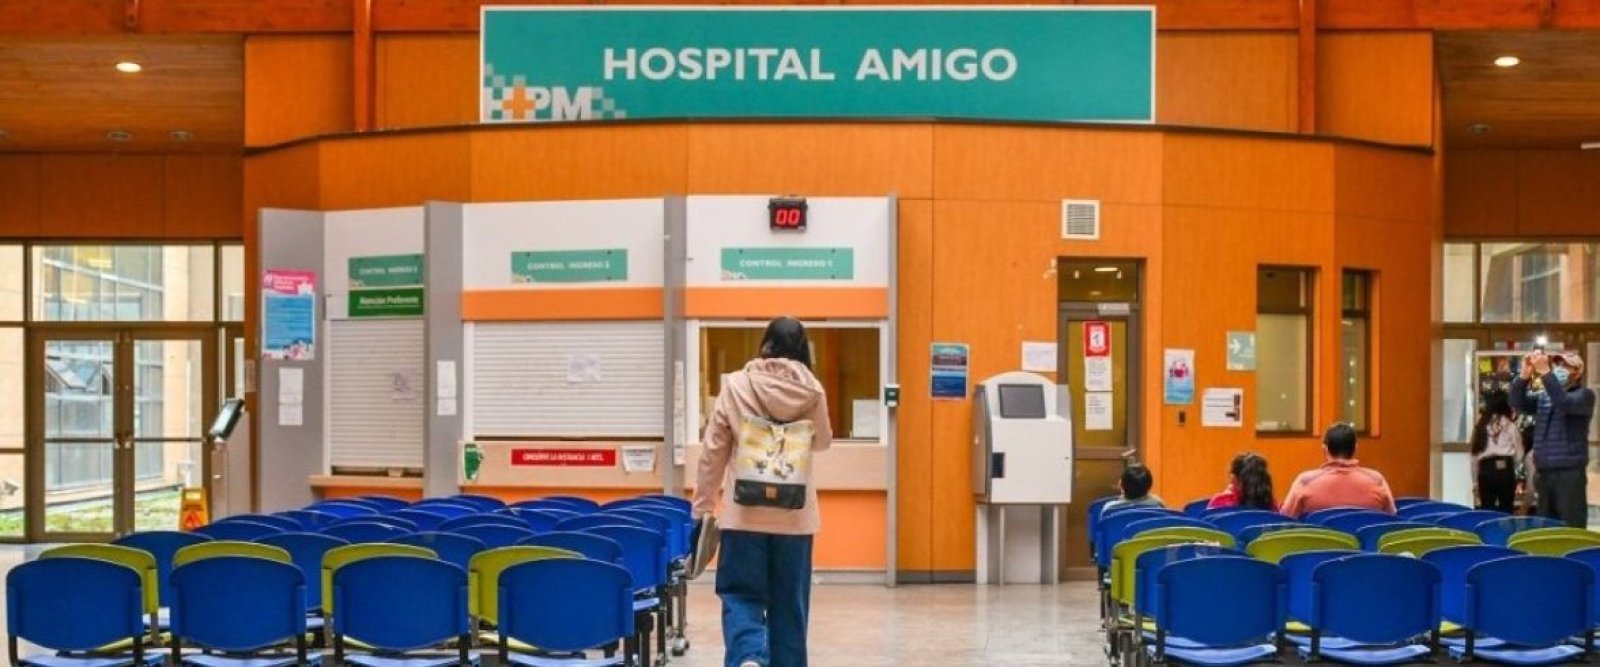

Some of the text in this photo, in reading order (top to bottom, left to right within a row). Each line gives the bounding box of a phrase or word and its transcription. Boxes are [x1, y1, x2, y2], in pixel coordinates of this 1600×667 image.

[603, 47, 1018, 81] HOSPITAL AMIGO
[775, 208, 801, 224] 00
[527, 262, 564, 270] CONTROL
[569, 261, 603, 270] INGRESO
[739, 260, 781, 268] CONTROL
[787, 260, 825, 268] INGRESO
